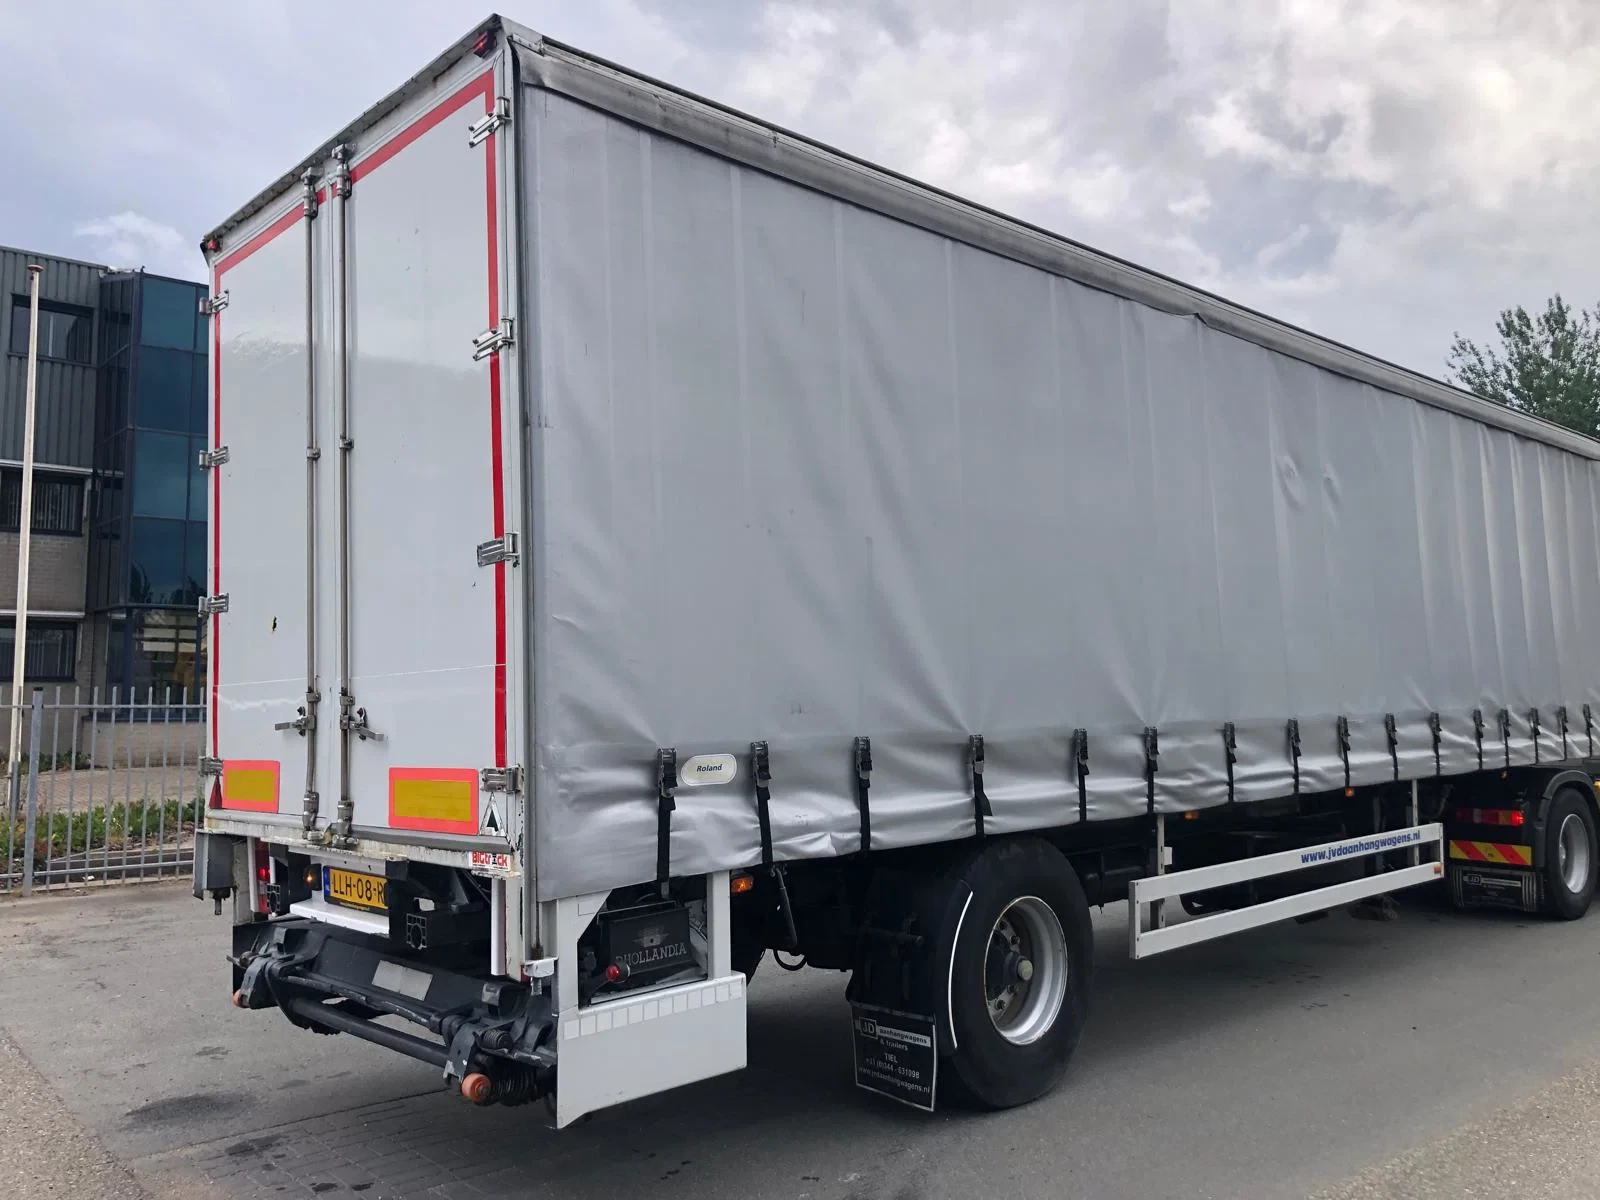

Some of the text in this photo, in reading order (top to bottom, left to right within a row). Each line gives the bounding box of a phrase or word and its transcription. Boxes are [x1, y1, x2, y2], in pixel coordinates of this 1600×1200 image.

[696, 764, 723, 773] Roland
[1301, 831, 1421, 863] www.jvdaanhangwagens.nl
[880, 1028, 927, 1043] aanhangwagens
[898, 1066, 920, 1079] 631098
